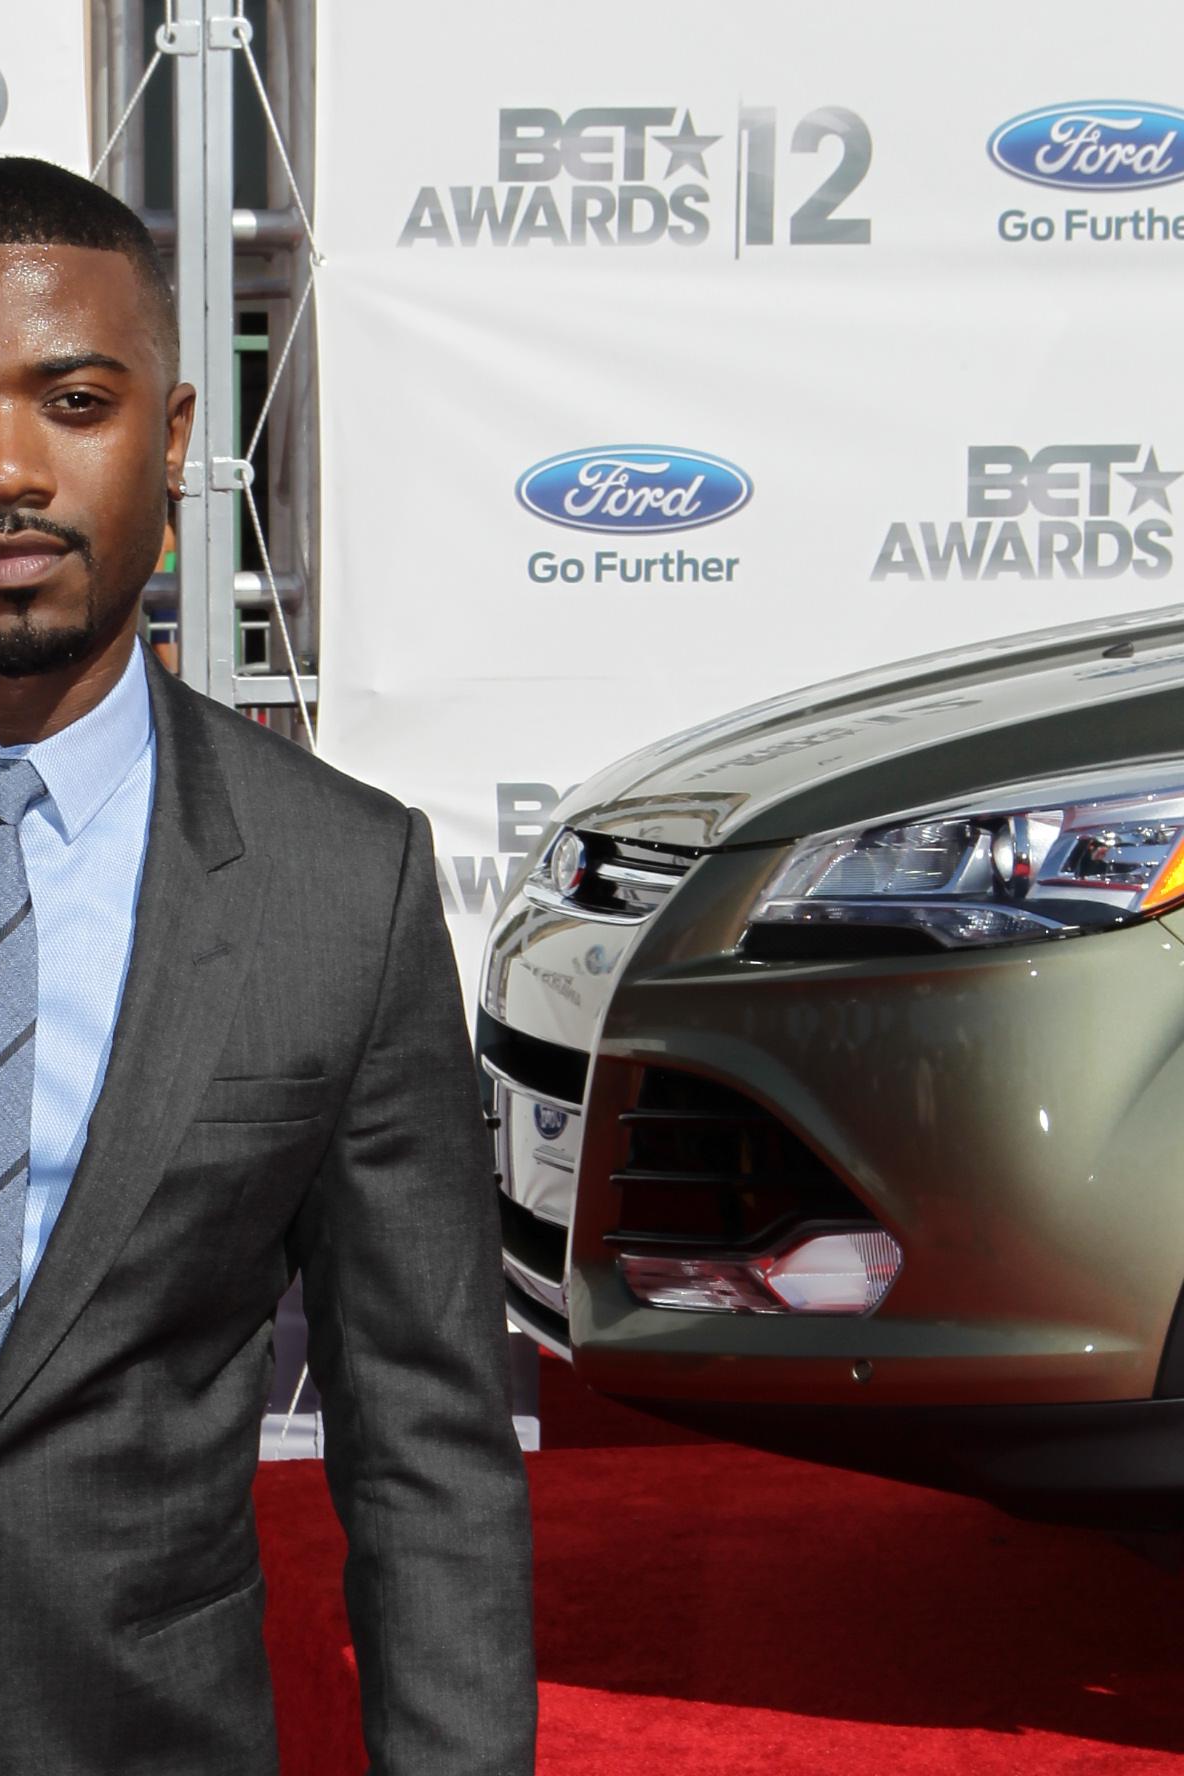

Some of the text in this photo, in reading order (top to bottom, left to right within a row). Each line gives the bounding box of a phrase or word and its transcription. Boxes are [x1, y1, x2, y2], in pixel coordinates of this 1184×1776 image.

[497, 106, 678, 183] BET
[739, 105, 874, 246] 12
[1035, 115, 1178, 174] Ford
[396, 183, 711, 248] AWARDS
[998, 207, 1184, 243] Go Furth
[563, 458, 706, 518] Ford
[966, 444, 1142, 519] BET
[527, 549, 740, 584] Go Further
[868, 517, 1174, 582] AWARDS
